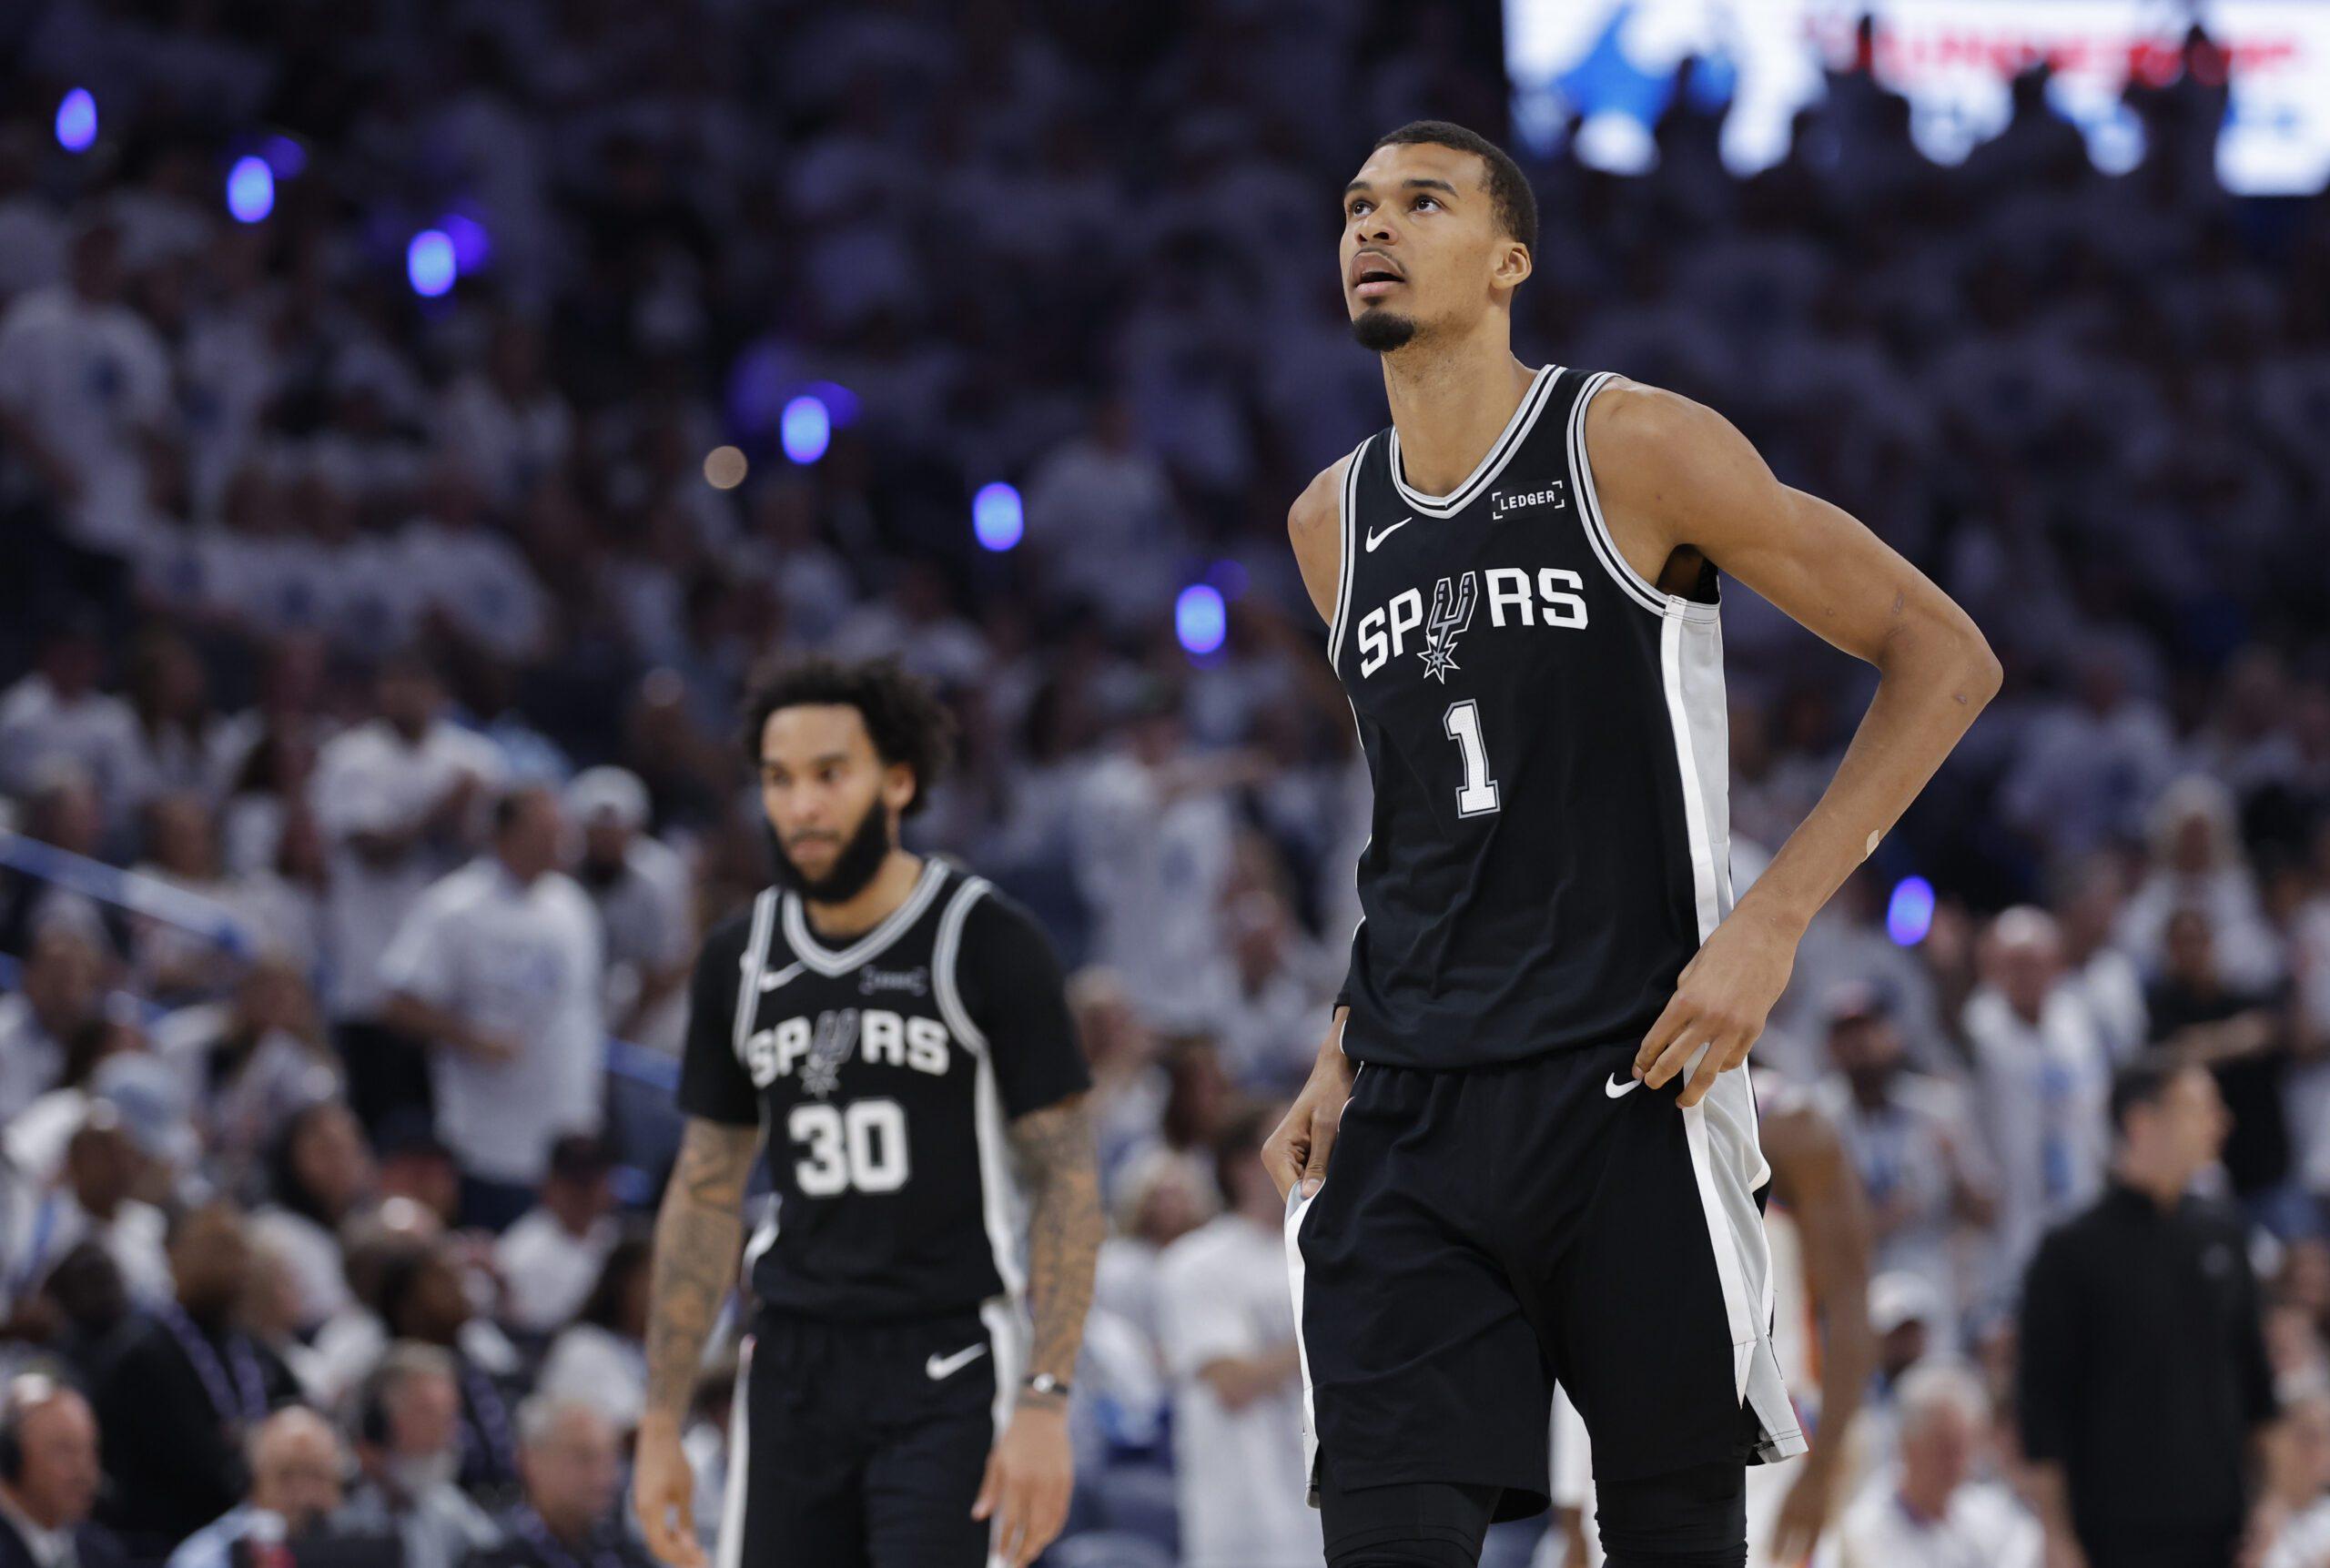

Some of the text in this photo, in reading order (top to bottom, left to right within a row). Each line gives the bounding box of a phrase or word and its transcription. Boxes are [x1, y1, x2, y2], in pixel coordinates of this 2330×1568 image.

[1500, 490, 1555, 511] LEDGER
[1357, 566, 1589, 684] SPURS
[1443, 698, 1501, 819] 1
[746, 1007, 949, 1098] SPURS
[788, 1098, 908, 1197] 30
